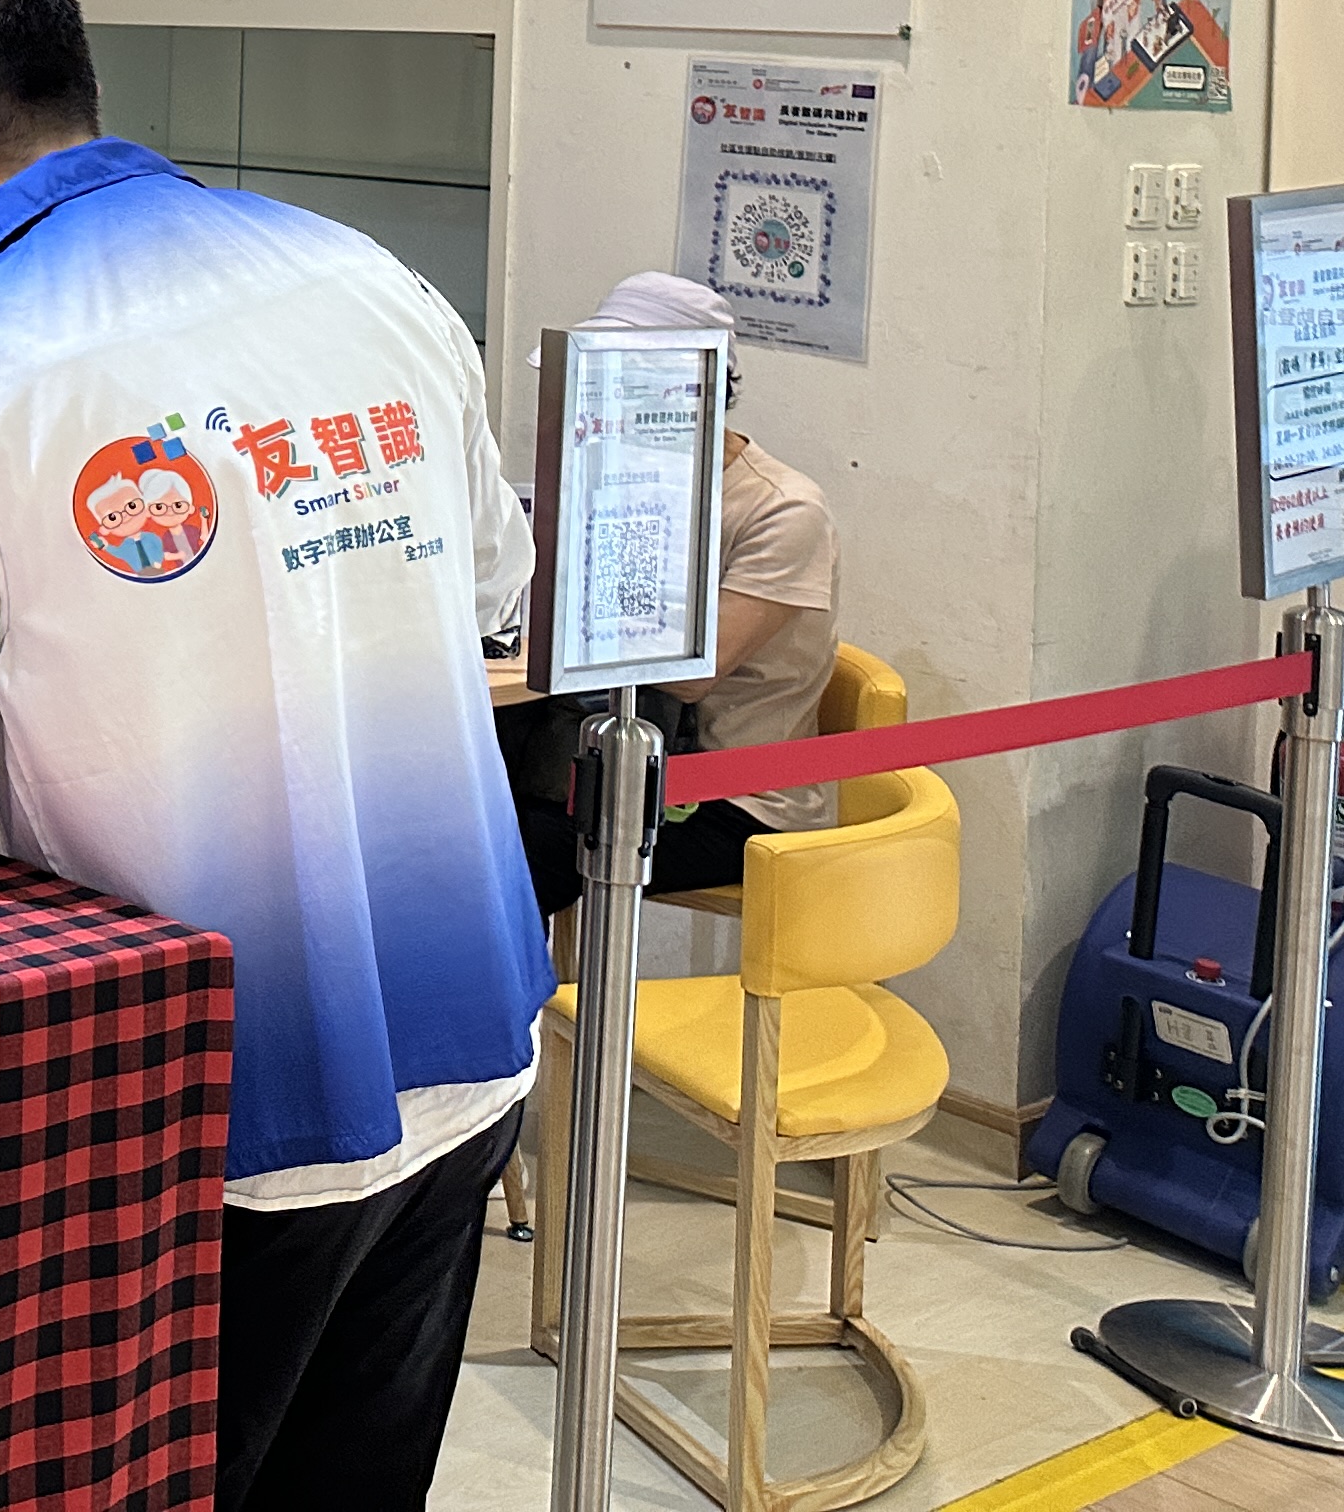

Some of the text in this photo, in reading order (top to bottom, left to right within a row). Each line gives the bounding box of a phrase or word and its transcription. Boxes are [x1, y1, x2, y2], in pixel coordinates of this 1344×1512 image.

[233, 399, 424, 501] 友智識
[294, 477, 401, 516] Smart Silver
[282, 514, 414, 573] 數字政策辦公室
[404, 536, 444, 563] 全力支持
